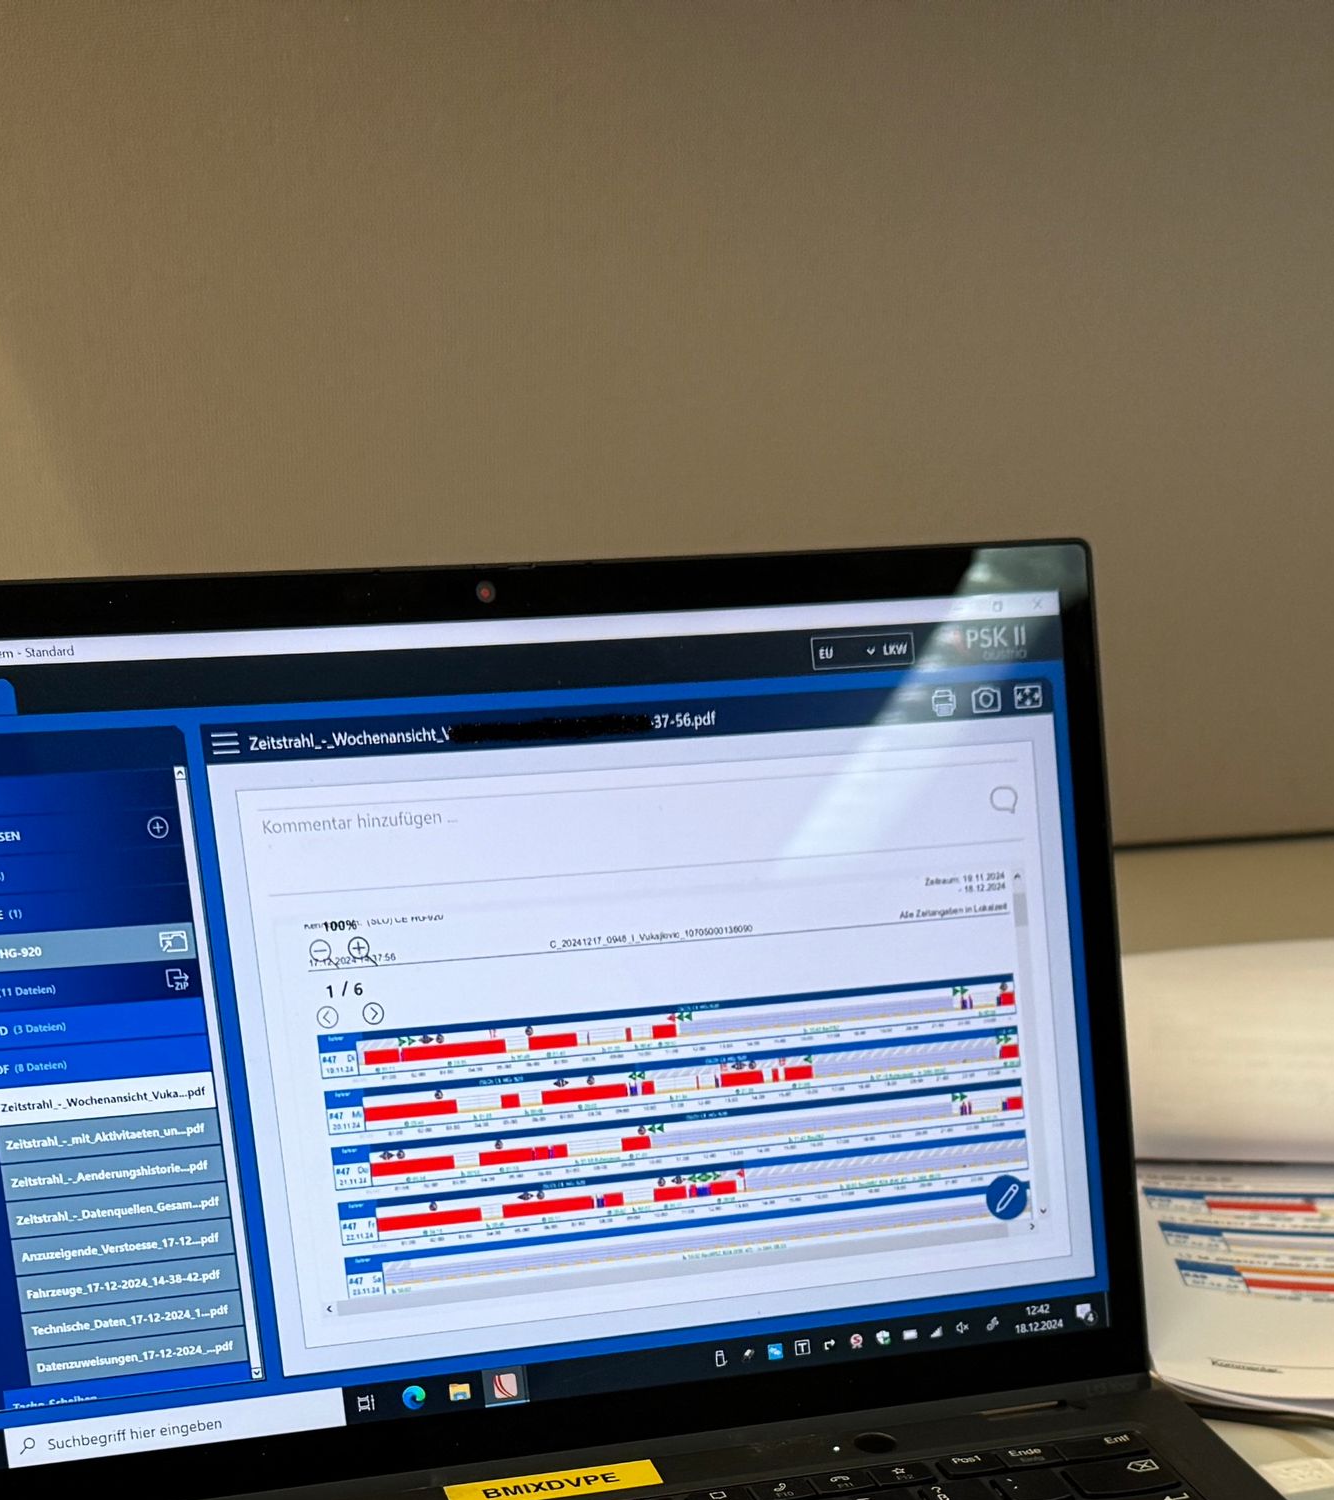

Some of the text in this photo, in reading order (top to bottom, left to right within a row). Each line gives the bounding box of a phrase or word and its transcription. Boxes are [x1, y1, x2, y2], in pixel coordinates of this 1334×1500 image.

[967, 626, 1009, 648] PSK
[25, 645, 75, 658] Standard
[883, 643, 908, 656] LKW
[261, 810, 442, 835] Kommentar hinzufügen
[9, 909, 23, 921] (1)
[324, 920, 357, 932] 100%
[0, 946, 42, 959] HG-920
[15, 984, 56, 998] Dateien)
[175, 981, 189, 991] ZIP
[326, 982, 363, 998] 1 6
[26, 1021, 66, 1034] Dateien)
[26, 1060, 67, 1073] Dateien)
[1025, 1303, 1050, 1316] 12:42
[1015, 1319, 1064, 1334] 18.12.2024
[48, 1419, 223, 1452] Suchbegriff hier eingeben
[1007, 1448, 1042, 1457] Ende
[951, 1454, 982, 1465] Pos1
[482, 1472, 620, 1500] BMIXDVPE
